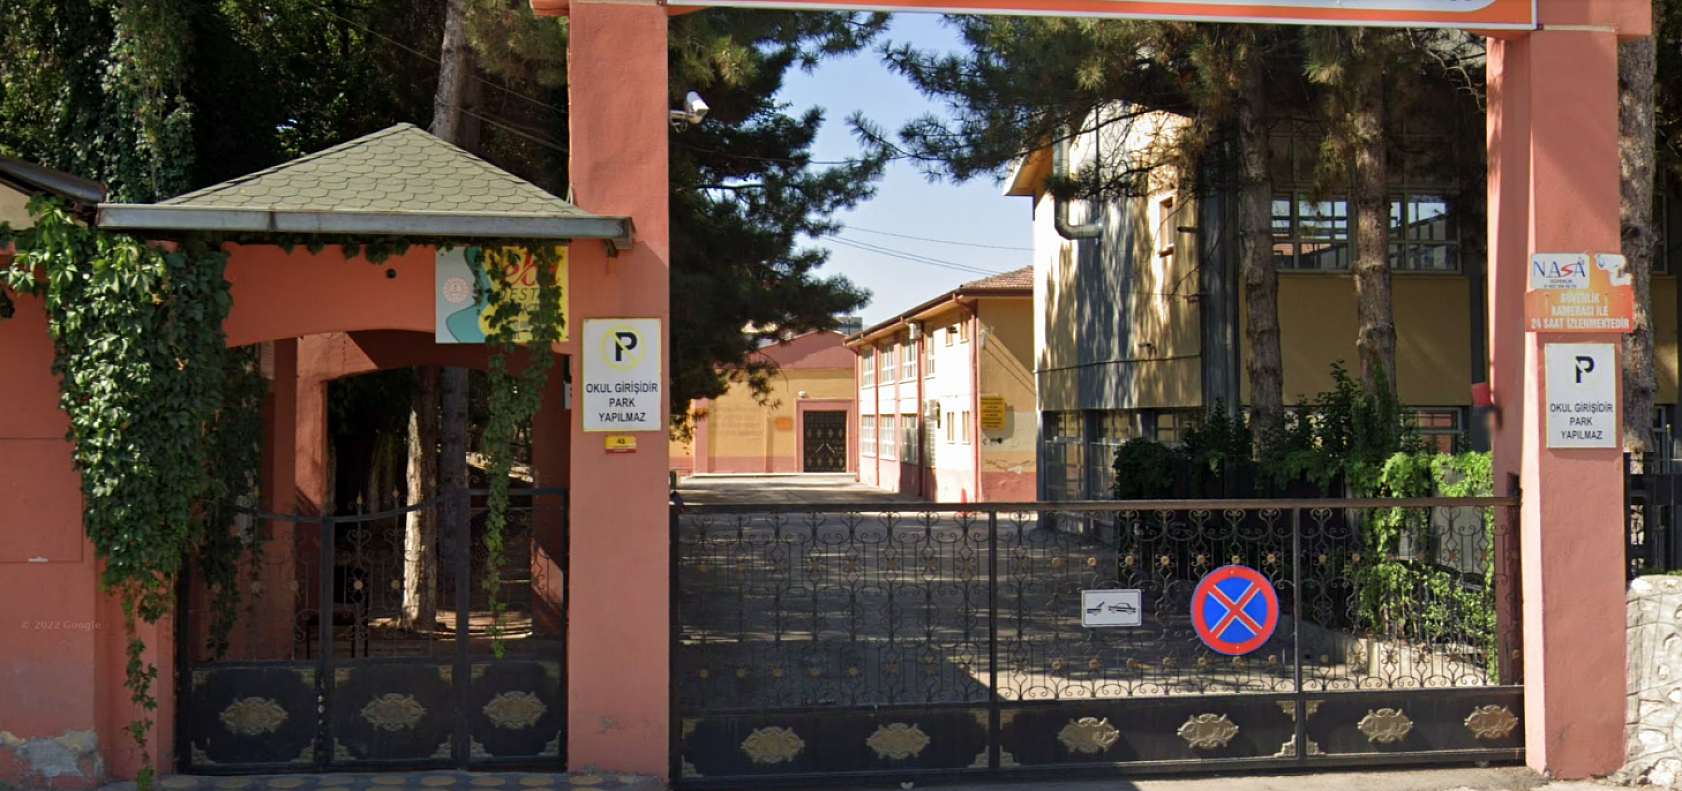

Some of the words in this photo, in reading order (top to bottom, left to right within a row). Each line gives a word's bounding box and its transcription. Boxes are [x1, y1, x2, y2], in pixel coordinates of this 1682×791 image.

[1533, 261, 1585, 278] NASA
[1561, 291, 1600, 303] GÜVENLİK
[1552, 305, 1594, 316] KAMERASI
[1596, 304, 1608, 316] İLE
[1531, 318, 1541, 329] 24
[1544, 318, 1564, 329] SAAT
[1567, 316, 1629, 329] İZLENMEKTEDİR
[615, 332, 638, 361] P
[586, 383, 612, 393] OKUL
[614, 380, 658, 394] GİRİŞİDİR
[609, 397, 636, 407] PARK
[1550, 402, 1572, 413] OKUL
[1574, 400, 1613, 414] GİRİŞİDİR
[598, 412, 646, 422] YAPILMAZ
[1569, 416, 1592, 426] PARK
[1561, 430, 1603, 440] YAPILMAZ
